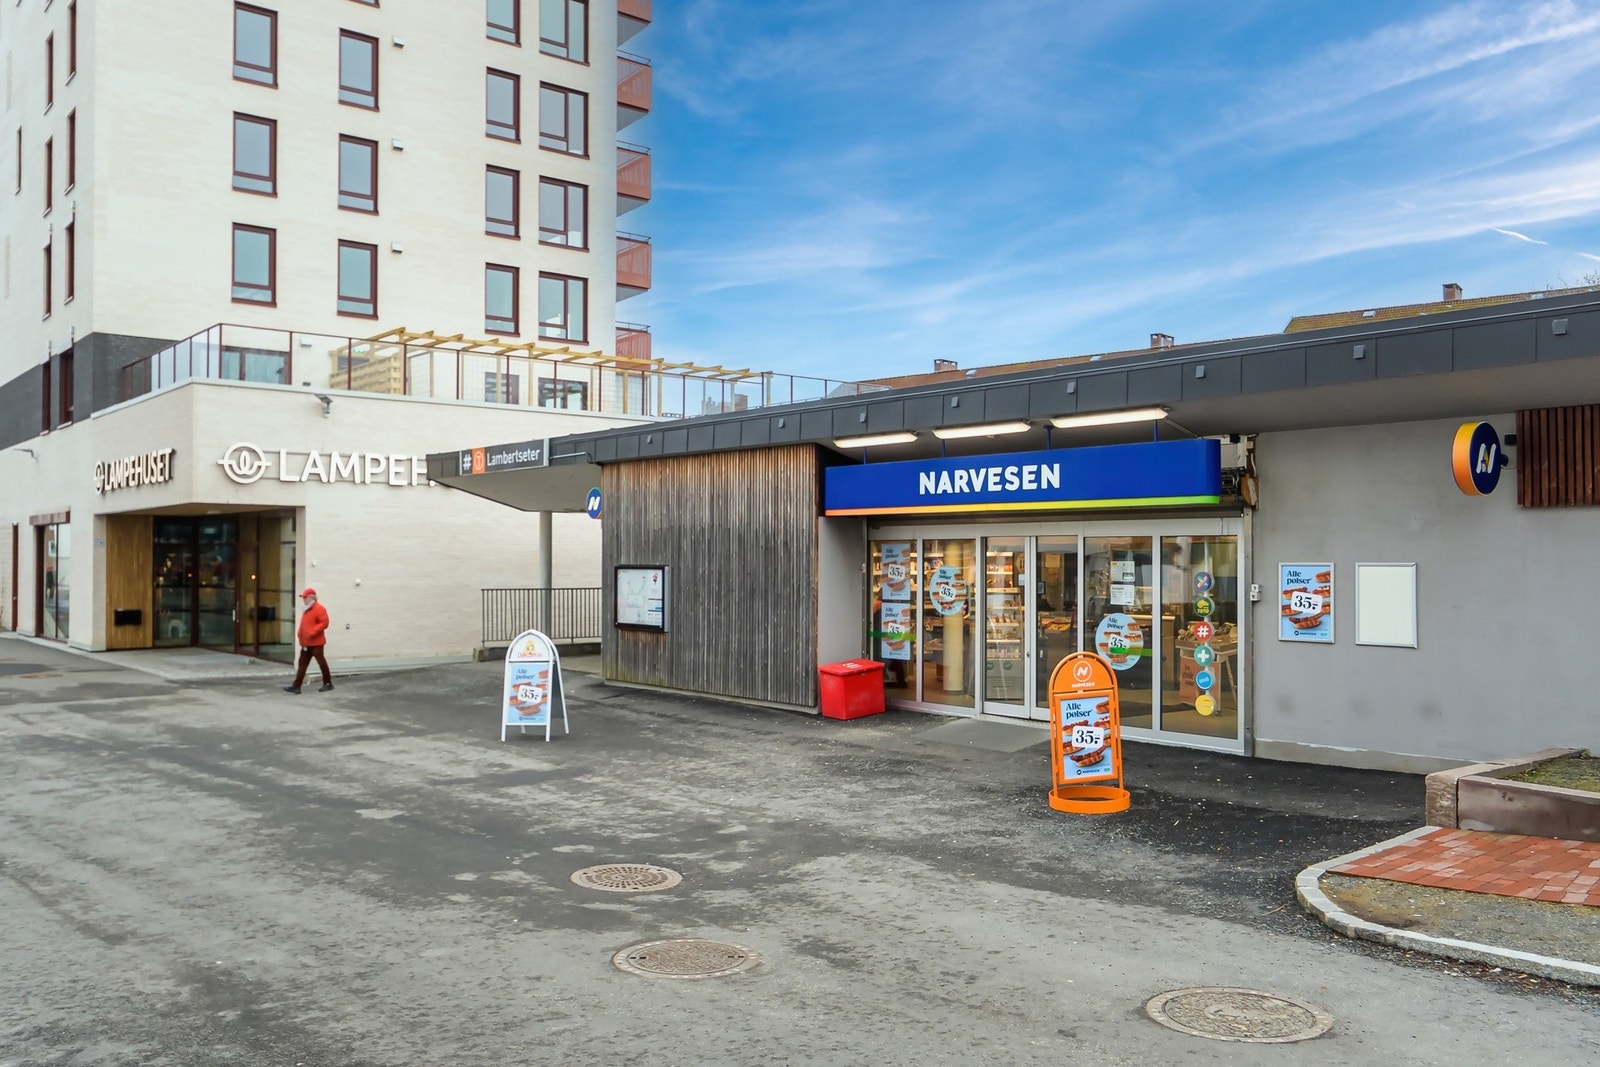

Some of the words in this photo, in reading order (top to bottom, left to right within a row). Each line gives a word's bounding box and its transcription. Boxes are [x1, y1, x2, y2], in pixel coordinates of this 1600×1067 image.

[103, 447, 174, 492] LAMPEHUSET
[486, 448, 541, 467] Lambertseter
[919, 463, 1060, 495] NARVESEN
[1065, 702, 1081, 710] Alle
